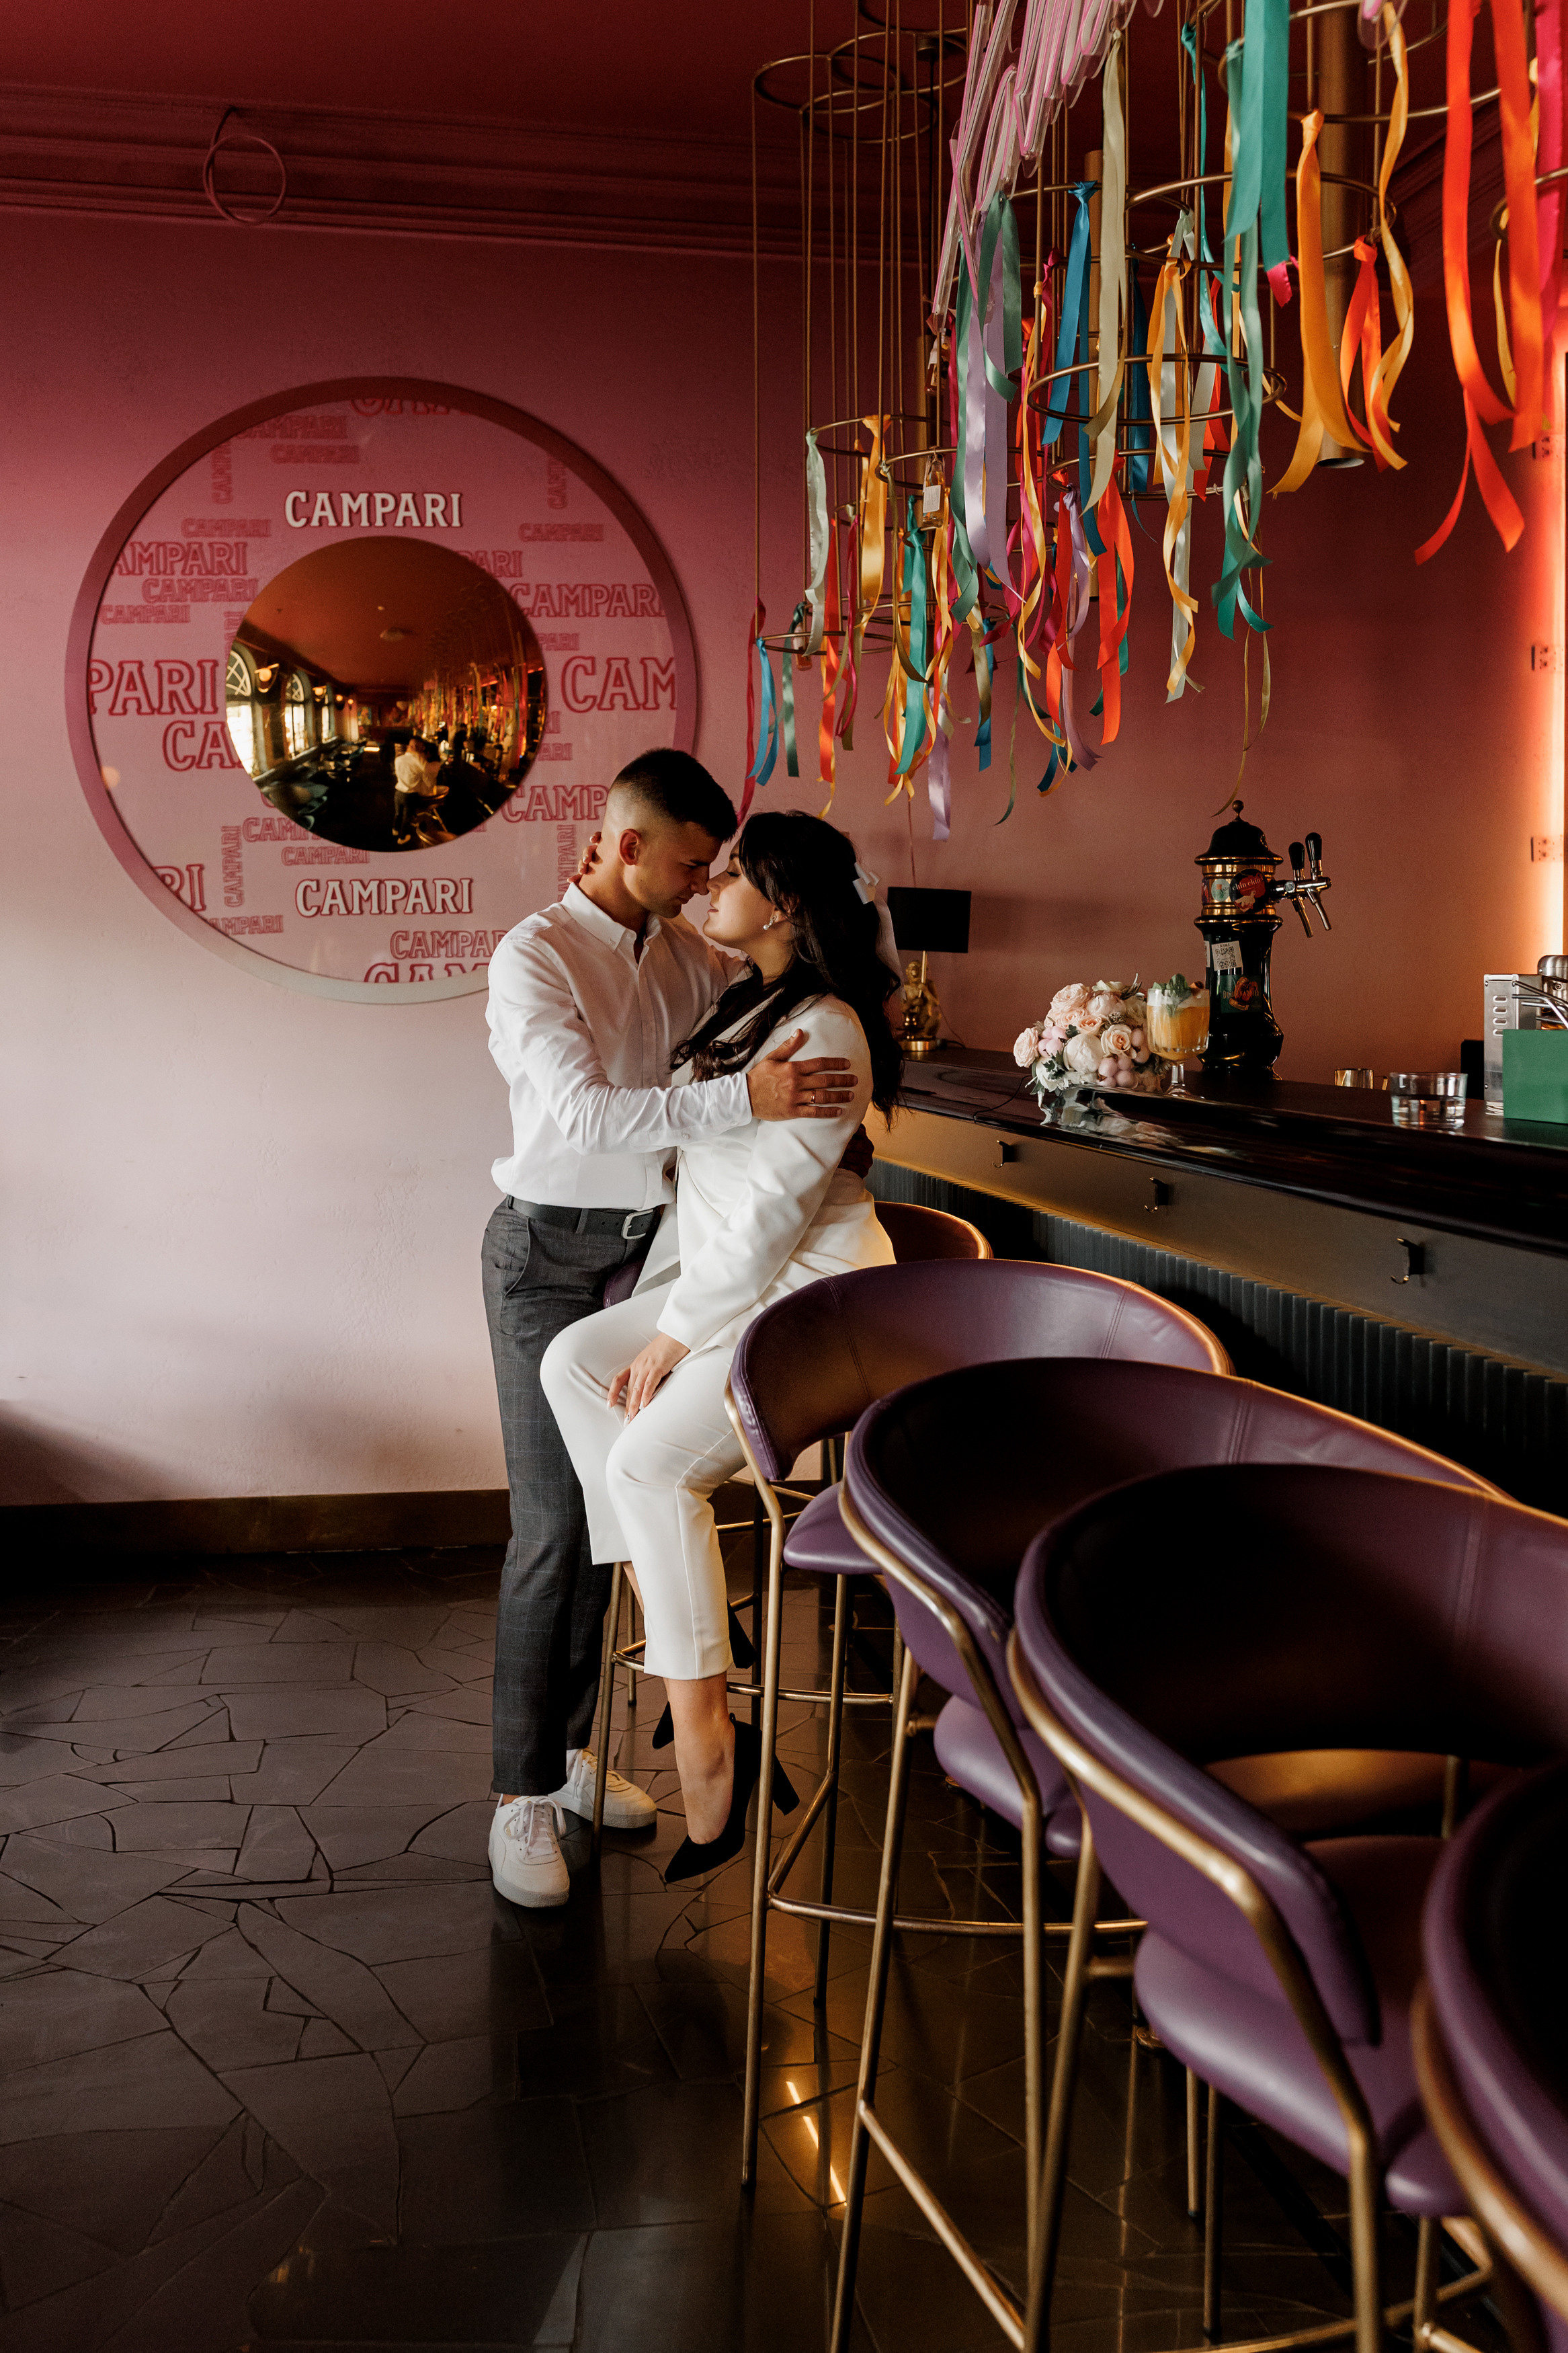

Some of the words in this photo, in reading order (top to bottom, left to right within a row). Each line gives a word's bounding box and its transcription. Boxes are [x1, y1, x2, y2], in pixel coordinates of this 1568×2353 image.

[284, 490, 462, 528] CAMPARI
[162, 720, 244, 771] CA
[220, 826, 245, 908] CAMPARI
[281, 846, 370, 866] CAMPARI
[295, 877, 474, 918] CAMPARI
